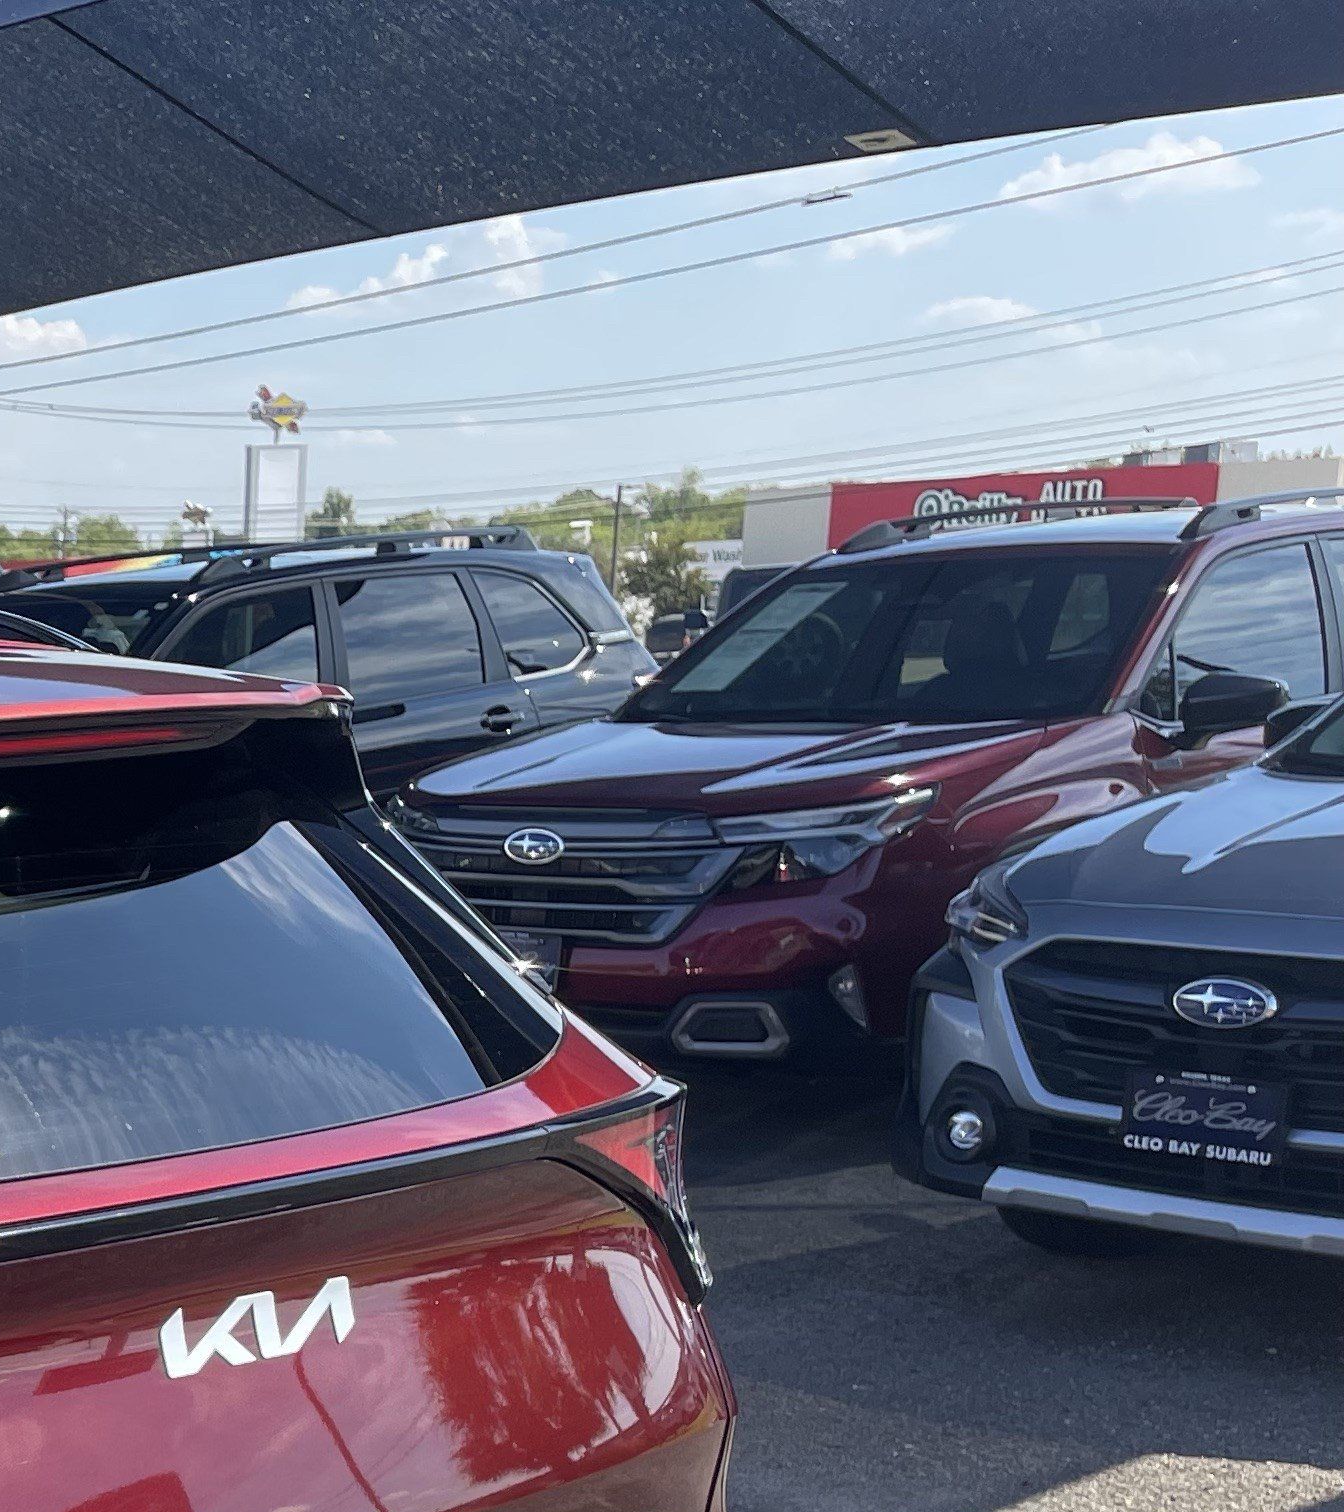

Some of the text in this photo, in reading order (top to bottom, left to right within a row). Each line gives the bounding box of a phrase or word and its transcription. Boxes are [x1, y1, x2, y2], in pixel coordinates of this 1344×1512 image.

[1039, 479, 1103, 503] AUTO
[1123, 1133, 1272, 1167] CLEO BAY SUBARU
[160, 1275, 355, 1379] KIA
